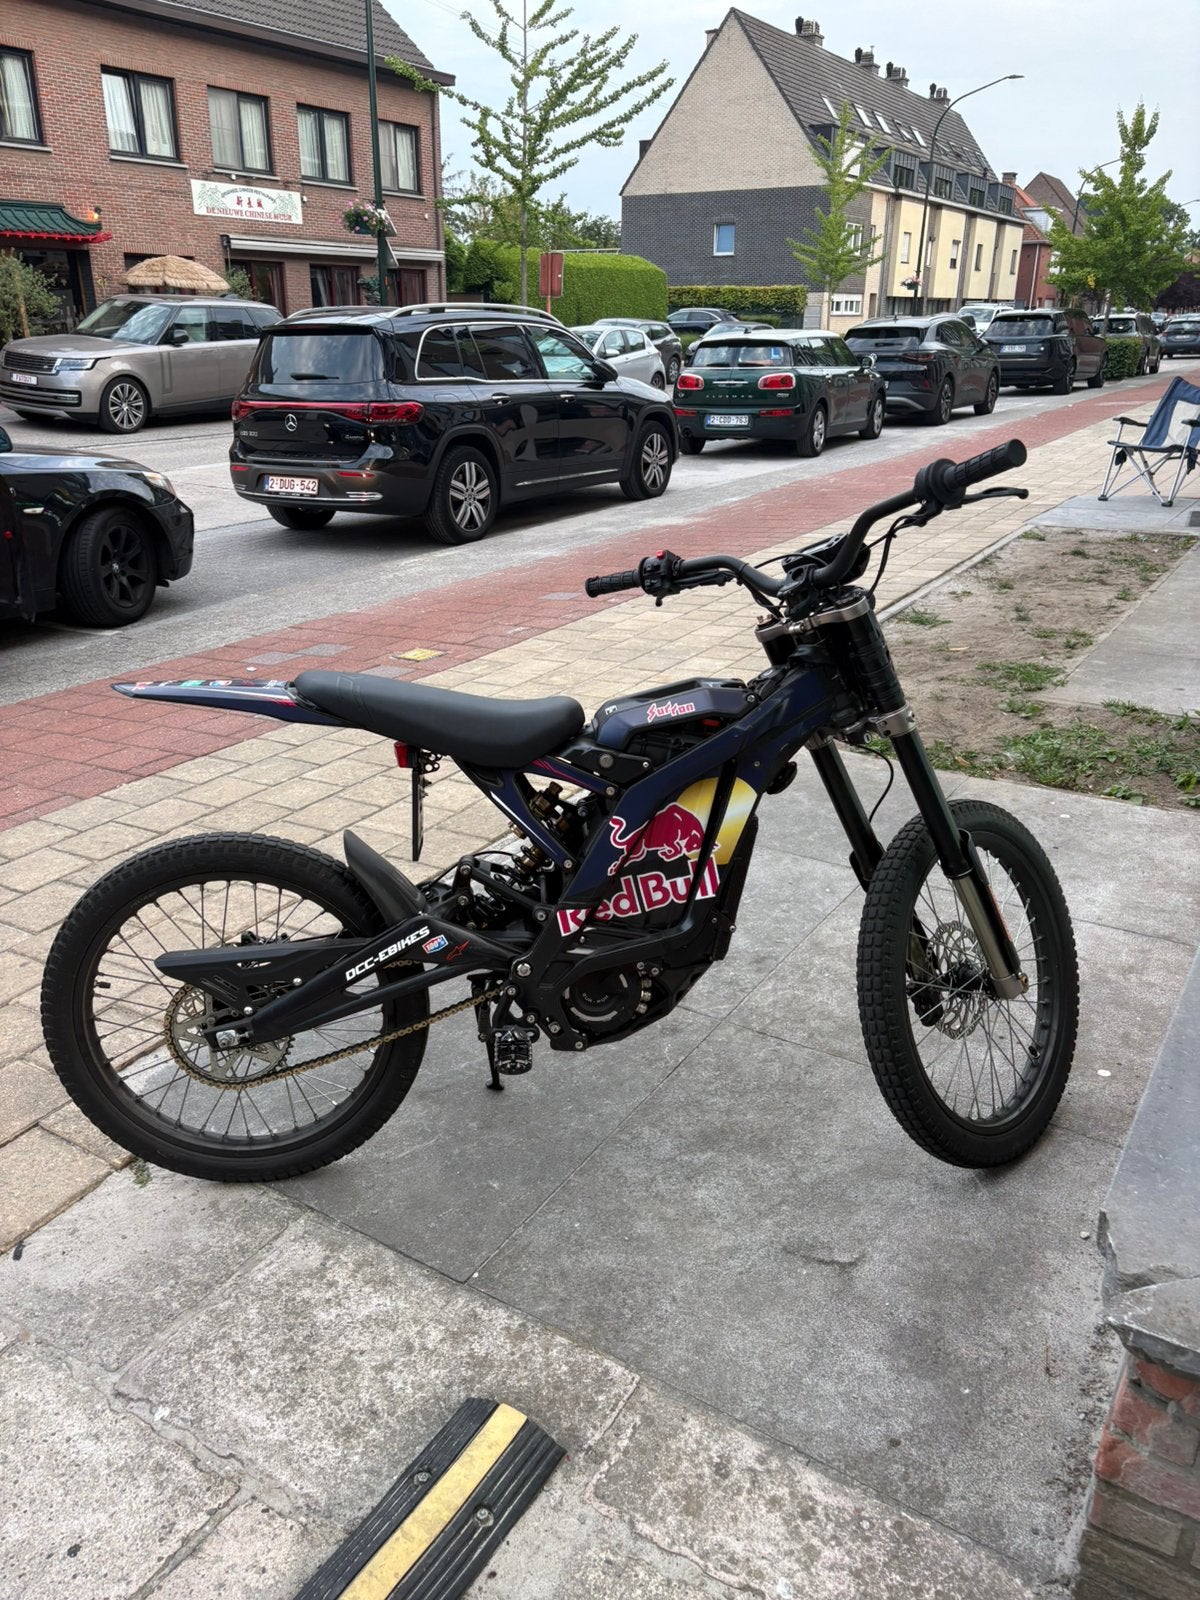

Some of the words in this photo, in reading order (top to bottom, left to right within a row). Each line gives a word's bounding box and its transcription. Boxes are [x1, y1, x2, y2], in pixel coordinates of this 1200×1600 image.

[206, 206, 217, 215] DE
[244, 210, 273, 220] CHINESE
[557, 875, 642, 937] Red
[637, 855, 721, 911] Bull
